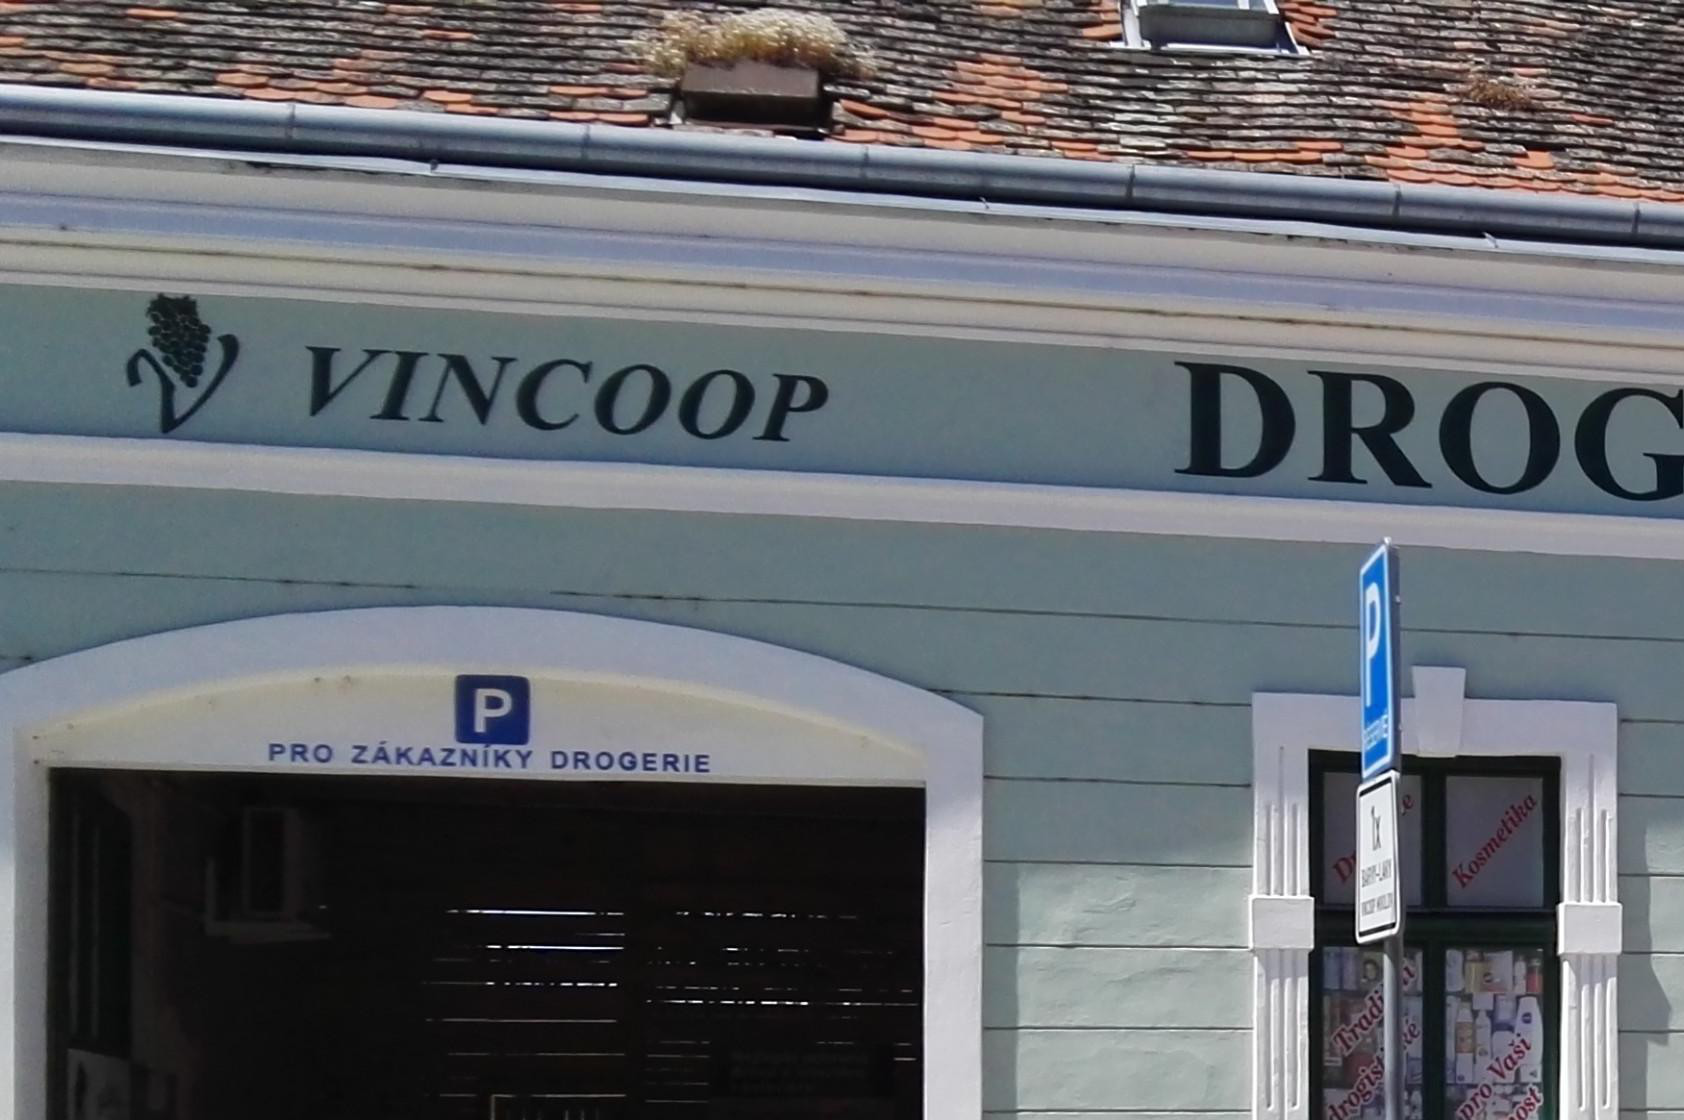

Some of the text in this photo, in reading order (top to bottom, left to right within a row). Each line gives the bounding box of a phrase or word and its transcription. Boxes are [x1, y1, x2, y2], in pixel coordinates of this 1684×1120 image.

[306, 346, 830, 442] VINCOOP
[1364, 581, 1381, 708] P
[473, 688, 512, 733] P
[268, 740, 711, 773] PRO ZÁKAZNÍKY DROGERIE
[1451, 794, 1537, 889] Kosmetika
[1487, 1033, 1532, 1080] Vaši
